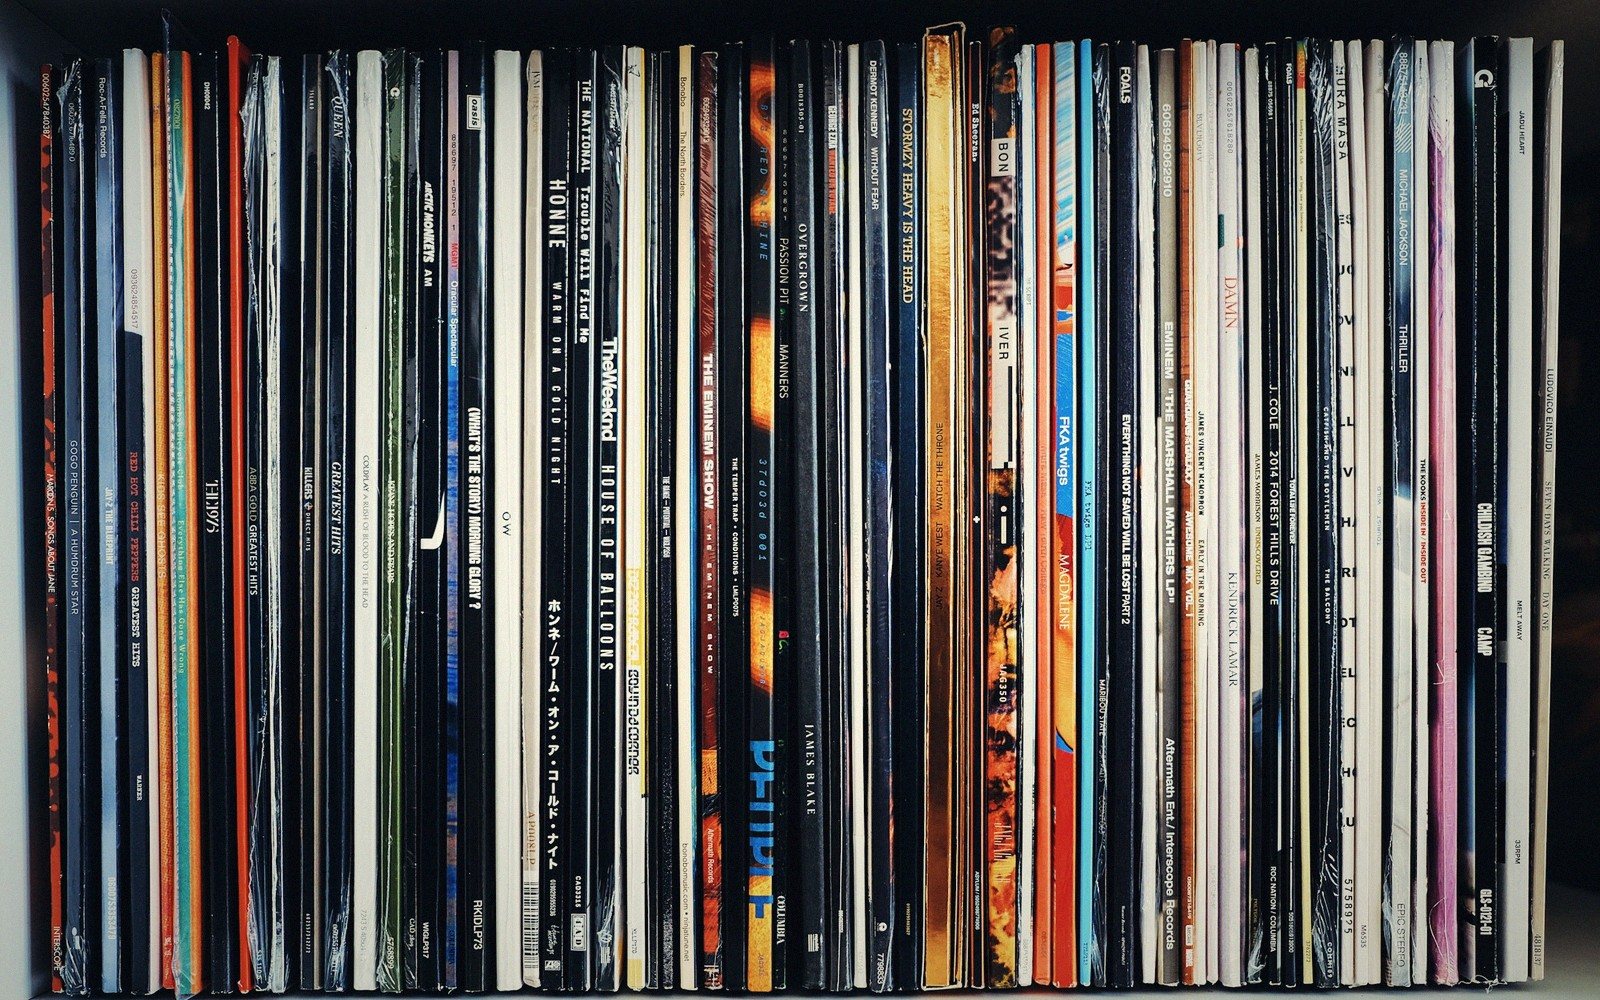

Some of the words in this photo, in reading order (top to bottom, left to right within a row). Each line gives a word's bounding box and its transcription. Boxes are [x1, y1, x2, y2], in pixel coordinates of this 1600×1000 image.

[582, 80, 592, 101] THE
[680, 77, 688, 107] Bonobo
[869, 60, 878, 97] DERMOT
[1119, 66, 1131, 104] FOALS
[42, 73, 50, 139] 00602547840387
[99, 77, 107, 123] Roc-A-Fella
[332, 96, 344, 138] QUEEN
[470, 98, 480, 126] oasis
[869, 98, 878, 138] KENNEDY
[972, 103, 980, 115] Ed
[100, 125, 108, 158] Records
[582, 110, 592, 173] NATIONAL
[902, 108, 913, 169] STORMZY
[1162, 104, 1172, 197] 606949062910
[870, 147, 879, 186] WITHOUT
[997, 142, 1009, 173] BON
[423, 181, 433, 211] ARCTIC
[679, 168, 687, 198] Borders.
[871, 187, 879, 210] FEAR
[902, 173, 913, 218] HEAVY
[1399, 169, 1408, 213] MICHAEL
[548, 179, 566, 248] HONNE
[580, 186, 591, 241] Trouble
[902, 221, 913, 233] IS
[423, 211, 435, 263] MONKEYS
[903, 236, 914, 262] THE
[1399, 218, 1408, 266] JACKSON
[423, 269, 433, 287] AM
[580, 248, 590, 280] Will
[779, 238, 789, 284] PASSION
[798, 224, 809, 312] OVERGROWN
[552, 282, 562, 324] WARM
[779, 288, 789, 305] PIT
[903, 266, 914, 303] HEAD
[579, 289, 590, 320] Find
[552, 337, 562, 354] ON
[579, 327, 589, 343] Me
[998, 327, 1009, 360] IVER
[1164, 321, 1175, 379] EMINEM
[1399, 324, 1408, 373] THRILLER
[703, 354, 713, 385] THE
[779, 344, 789, 398] MANNERS
[551, 385, 561, 424] COLD
[1164, 388, 1175, 422] "THE
[1269, 385, 1278, 396] J.
[1545, 368, 1553, 414] LUDOVICO
[467, 407, 481, 452] (WHAT'S
[703, 390, 714, 455] EMINEM
[1059, 416, 1070, 443] FKA
[1269, 398, 1279, 430] COLE
[1121, 414, 1130, 474] EVERYTHING
[1545, 417, 1553, 453] EINAUDI
[70, 440, 78, 469] GOGO
[130, 452, 138, 471] RED
[468, 455, 481, 473] THE
[551, 437, 561, 485] NIGHT
[1056, 445, 1070, 485] twigs
[1165, 426, 1175, 503] MARSHALL
[1269, 451, 1279, 478] 2014
[70, 472, 78, 515] PENGUIN
[130, 477, 138, 496] HOT
[331, 462, 341, 524] GREATEST
[467, 476, 481, 514] STORY)
[601, 465, 614, 525] HOUSE
[704, 459, 714, 509] SHOW
[1121, 476, 1130, 496] NOT
[130, 501, 139, 532] CHILI
[1121, 497, 1130, 529] SAVED
[1269, 482, 1279, 528] FOREST
[331, 526, 341, 555] HITS
[362, 521, 369, 532] OF
[468, 516, 481, 564] MORNING
[1121, 530, 1130, 552] WILL
[1165, 507, 1175, 576] MATHERS
[1420, 528, 1427, 536] IN
[1477, 503, 1492, 545] CHILDISH
[71, 538, 79, 588] HUMDRUM
[131, 538, 139, 581] PEPPERS
[362, 560, 369, 570] TO
[601, 538, 614, 560] OF
[1121, 554, 1130, 567] BE
[1270, 532, 1279, 565] HILLS
[1542, 539, 1551, 580] WALKING
[468, 567, 481, 599] GLORY
[1121, 568, 1130, 593] LOST
[1270, 570, 1279, 606] DRIVE
[1477, 547, 1492, 592] GAMBINO
[71, 591, 79, 615] STAR
[1059, 554, 1071, 630] MAGDALENE
[1121, 594, 1130, 616] PART
[1165, 579, 1175, 603] LP"
[1228, 572, 1238, 638] KENDRICK
[1542, 592, 1550, 609] DAY
[131, 586, 140, 638] GREATEST
[600, 572, 614, 671] BALLOONS
[132, 642, 140, 667] HITS
[1477, 627, 1492, 656] CAMP
[1228, 641, 1238, 687] LAMAR
[805, 724, 815, 767] JAMES
[1165, 738, 1175, 798] Aftermath
[806, 773, 816, 815] BLAKE
[1165, 802, 1176, 829] Ent./
[707, 828, 715, 857] Aftermath
[681, 843, 689, 910] bonobomusic.com
[707, 859, 715, 883] Records
[1164, 832, 1175, 896] Interscope
[1269, 866, 1277, 881] ROC
[1269, 883, 1277, 910] NATION
[473, 900, 483, 950] RKIDLP73
[776, 895, 786, 944] COLUMBIA
[1165, 900, 1175, 950] Records
[1269, 916, 1277, 952] COLUMBIA
[53, 926, 61, 971] INTERSCOPE
[681, 917, 690, 962] ninjatune.net
[1534, 934, 1542, 966] 4818137
